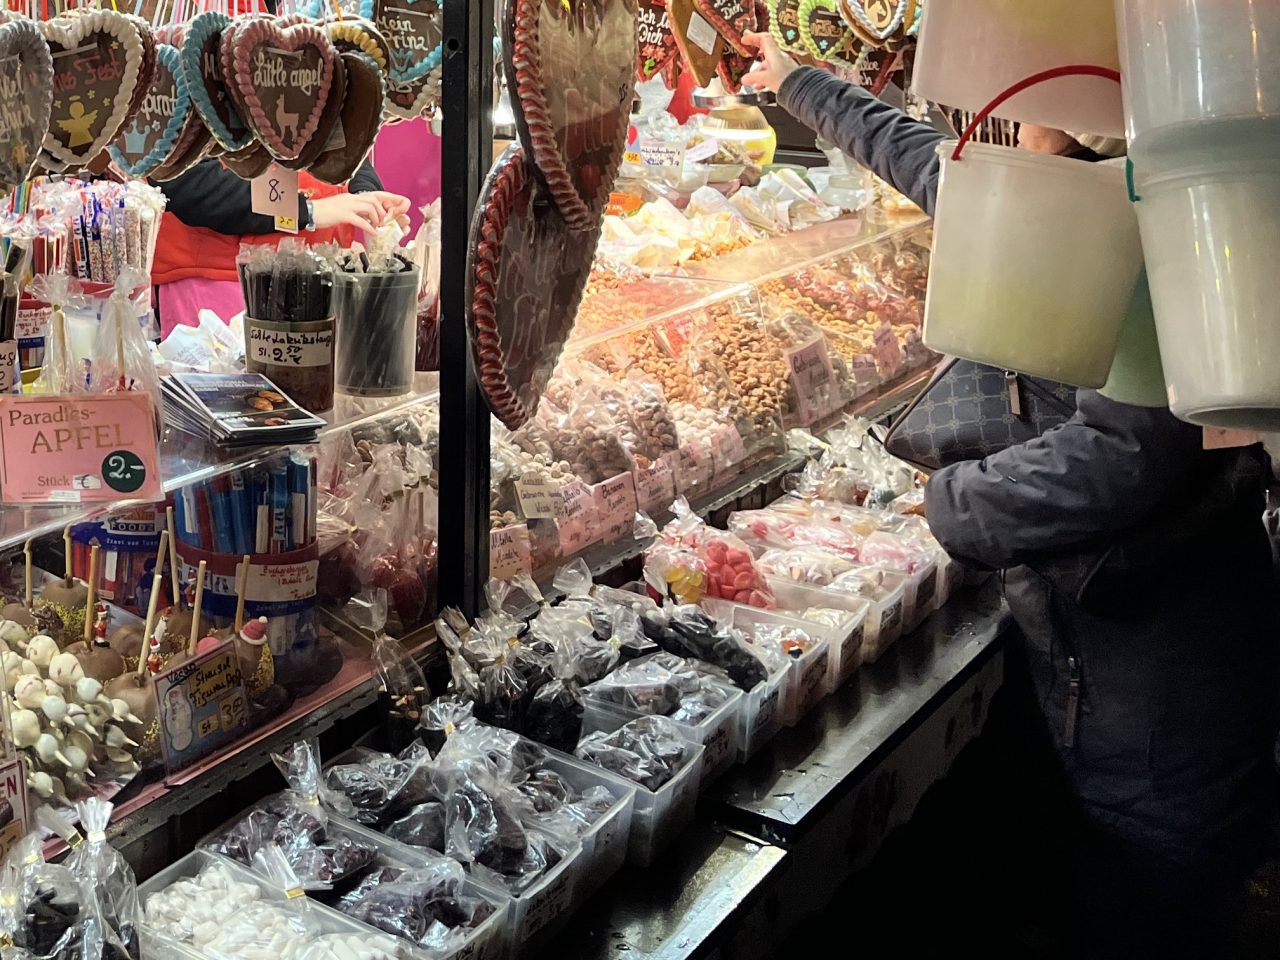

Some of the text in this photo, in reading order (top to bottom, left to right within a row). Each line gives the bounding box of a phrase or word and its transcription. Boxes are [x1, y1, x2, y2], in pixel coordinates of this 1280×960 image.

[721, 0, 744, 20] Dich
[376, 14, 417, 34] Mein
[638, 24, 663, 46] Dich
[290, 57, 323, 96] angel
[9, 407, 96, 427] Paradies-
[30, 422, 135, 455] APFEL
[37, 474, 70, 487] Stück
